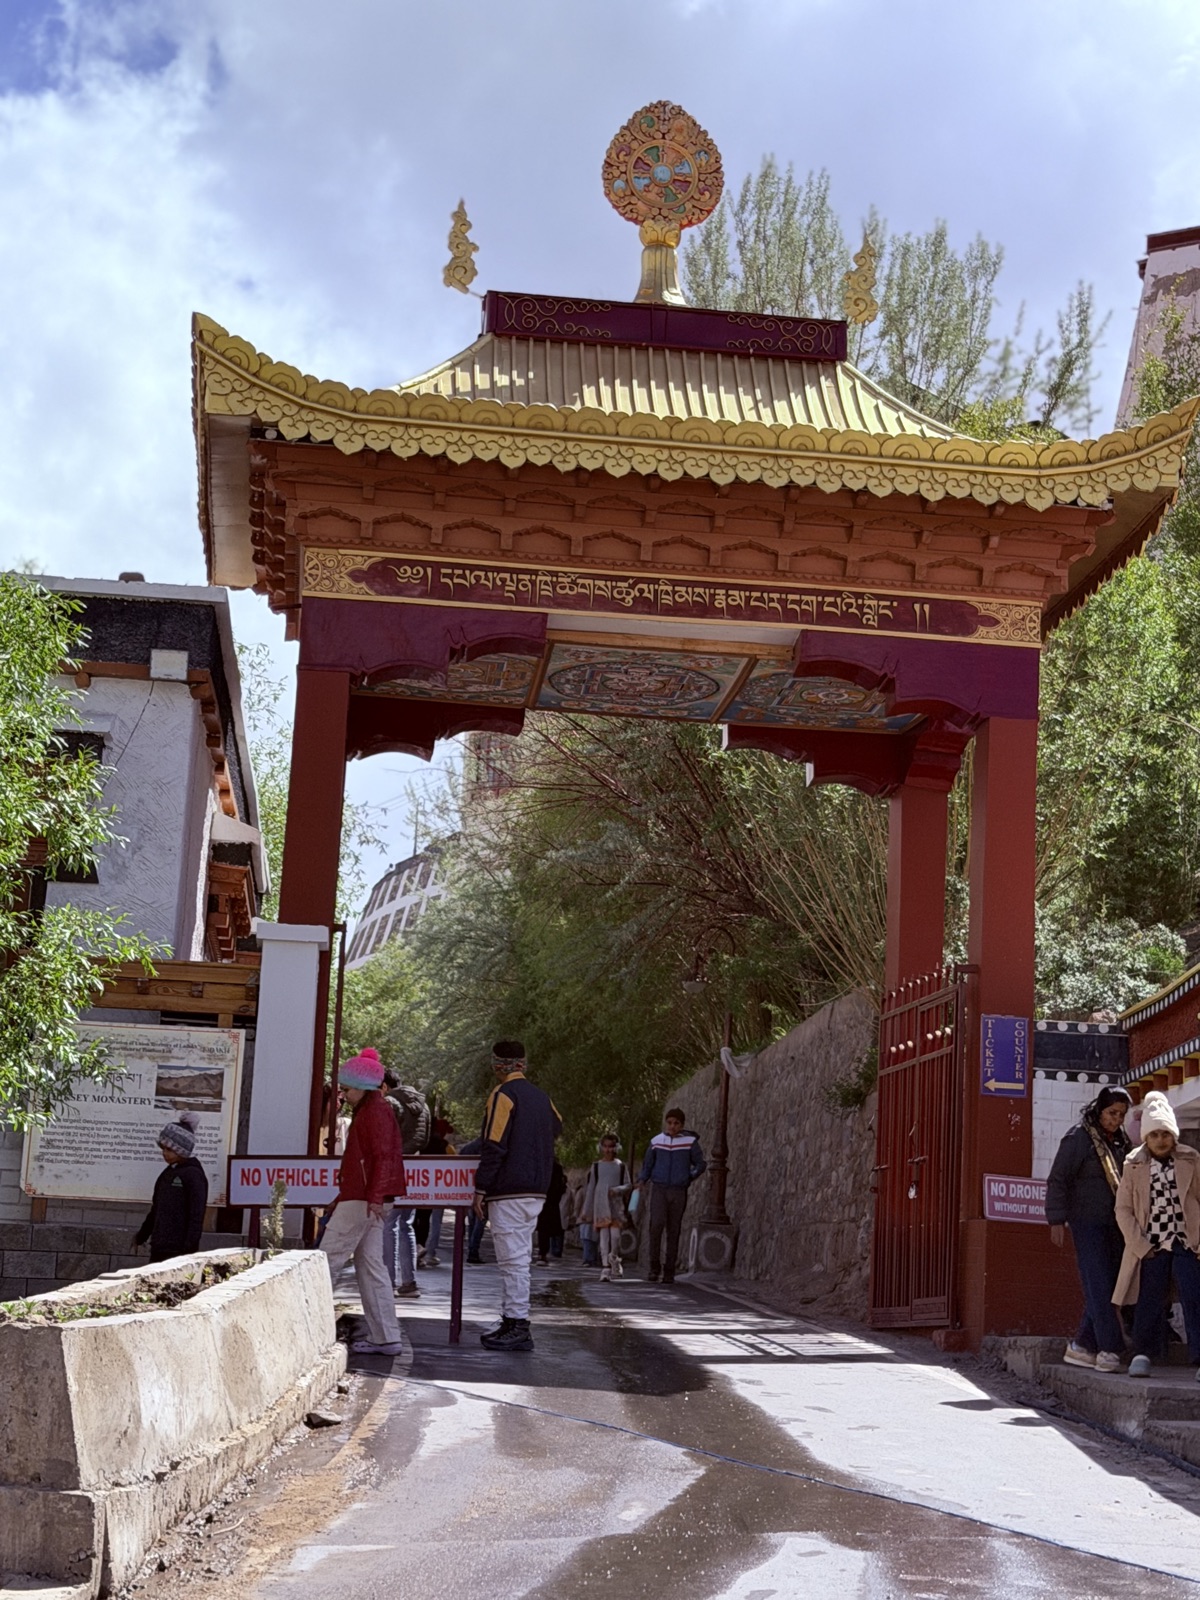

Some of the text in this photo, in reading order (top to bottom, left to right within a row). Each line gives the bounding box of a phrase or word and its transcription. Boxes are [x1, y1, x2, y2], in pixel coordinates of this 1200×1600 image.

[984, 1019, 995, 1077] TICKET
[1014, 1021, 1025, 1079] COUNTER
[91, 1093, 153, 1106] MONASTERY
[240, 1167, 262, 1187] NO
[265, 1167, 328, 1188] VEHICLE
[405, 1168, 431, 1188] HIS
[434, 1168, 476, 1188] POINT
[990, 1182, 1007, 1198] NO
[994, 1201, 1027, 1214] WITHOUT
